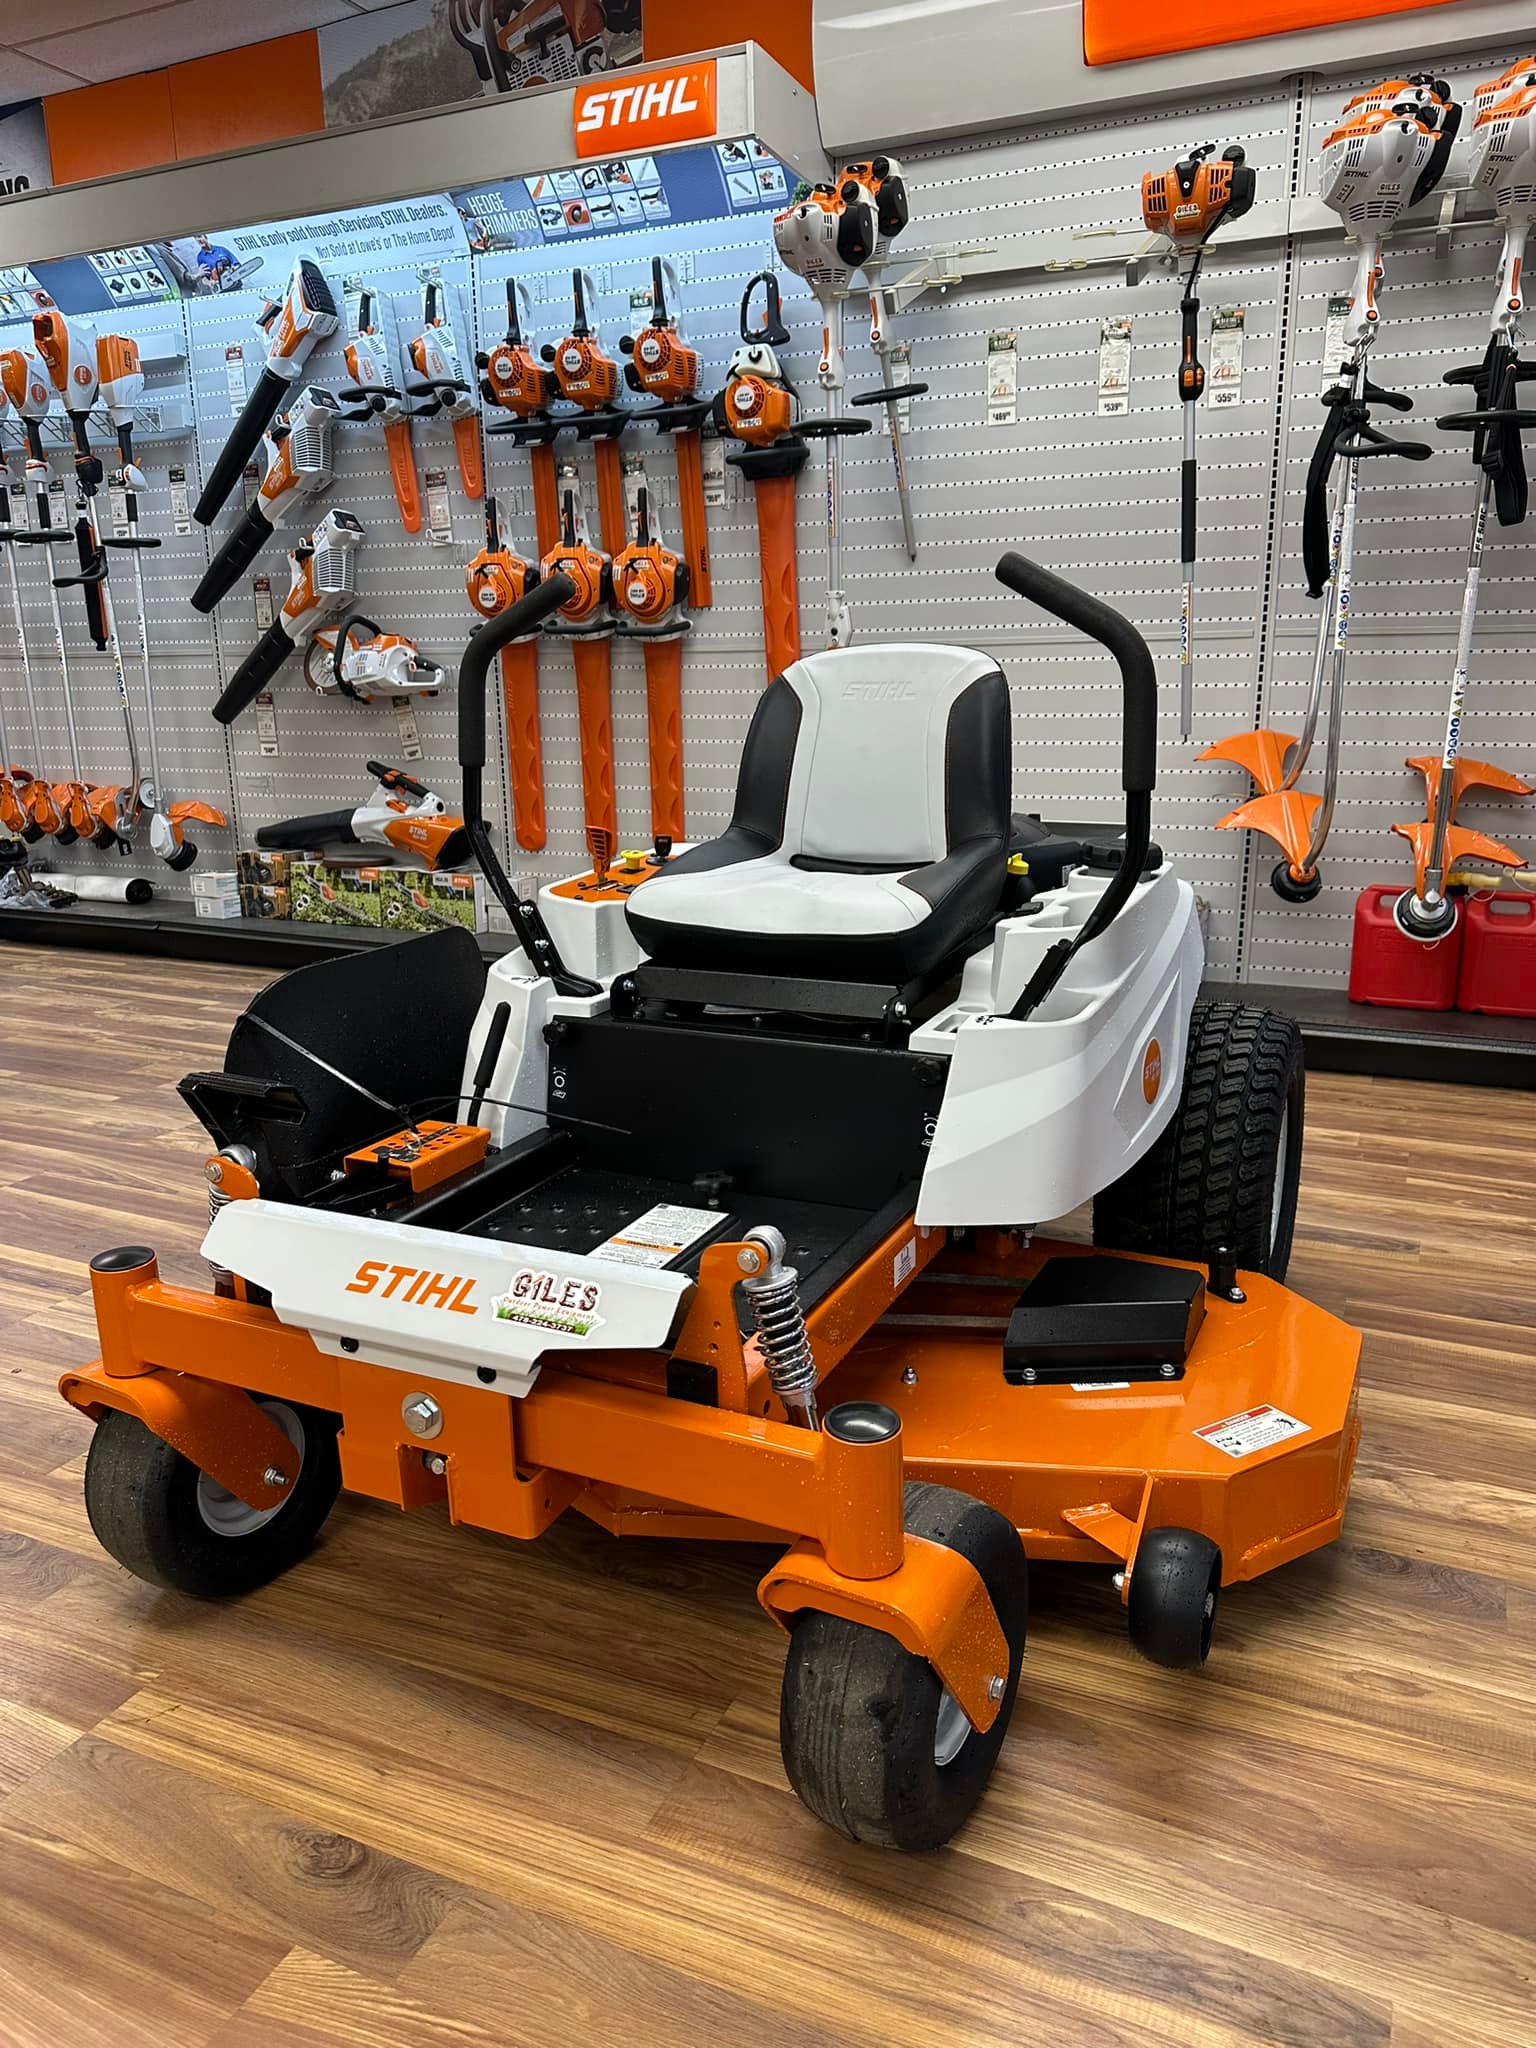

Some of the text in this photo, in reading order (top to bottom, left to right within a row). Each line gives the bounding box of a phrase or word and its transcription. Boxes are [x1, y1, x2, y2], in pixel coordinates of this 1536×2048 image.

[577, 77, 698, 132] STIHL
[1344, 170, 1369, 178] STIHL
[467, 192, 507, 216] HEDGE
[233, 203, 448, 251] STIHL is only sold through Servicing STIHL Dealers.
[315, 244, 330, 259] Not
[329, 241, 348, 257] Sold
[348, 241, 357, 254] at
[383, 239, 392, 249] or
[391, 233, 409, 248] The
[408, 229, 432, 245] Home
[432, 225, 455, 241] Depot
[842, 680, 918, 699] STIHL
[345, 1260, 479, 1315] STIHL
[513, 1271, 599, 1311] GILES
